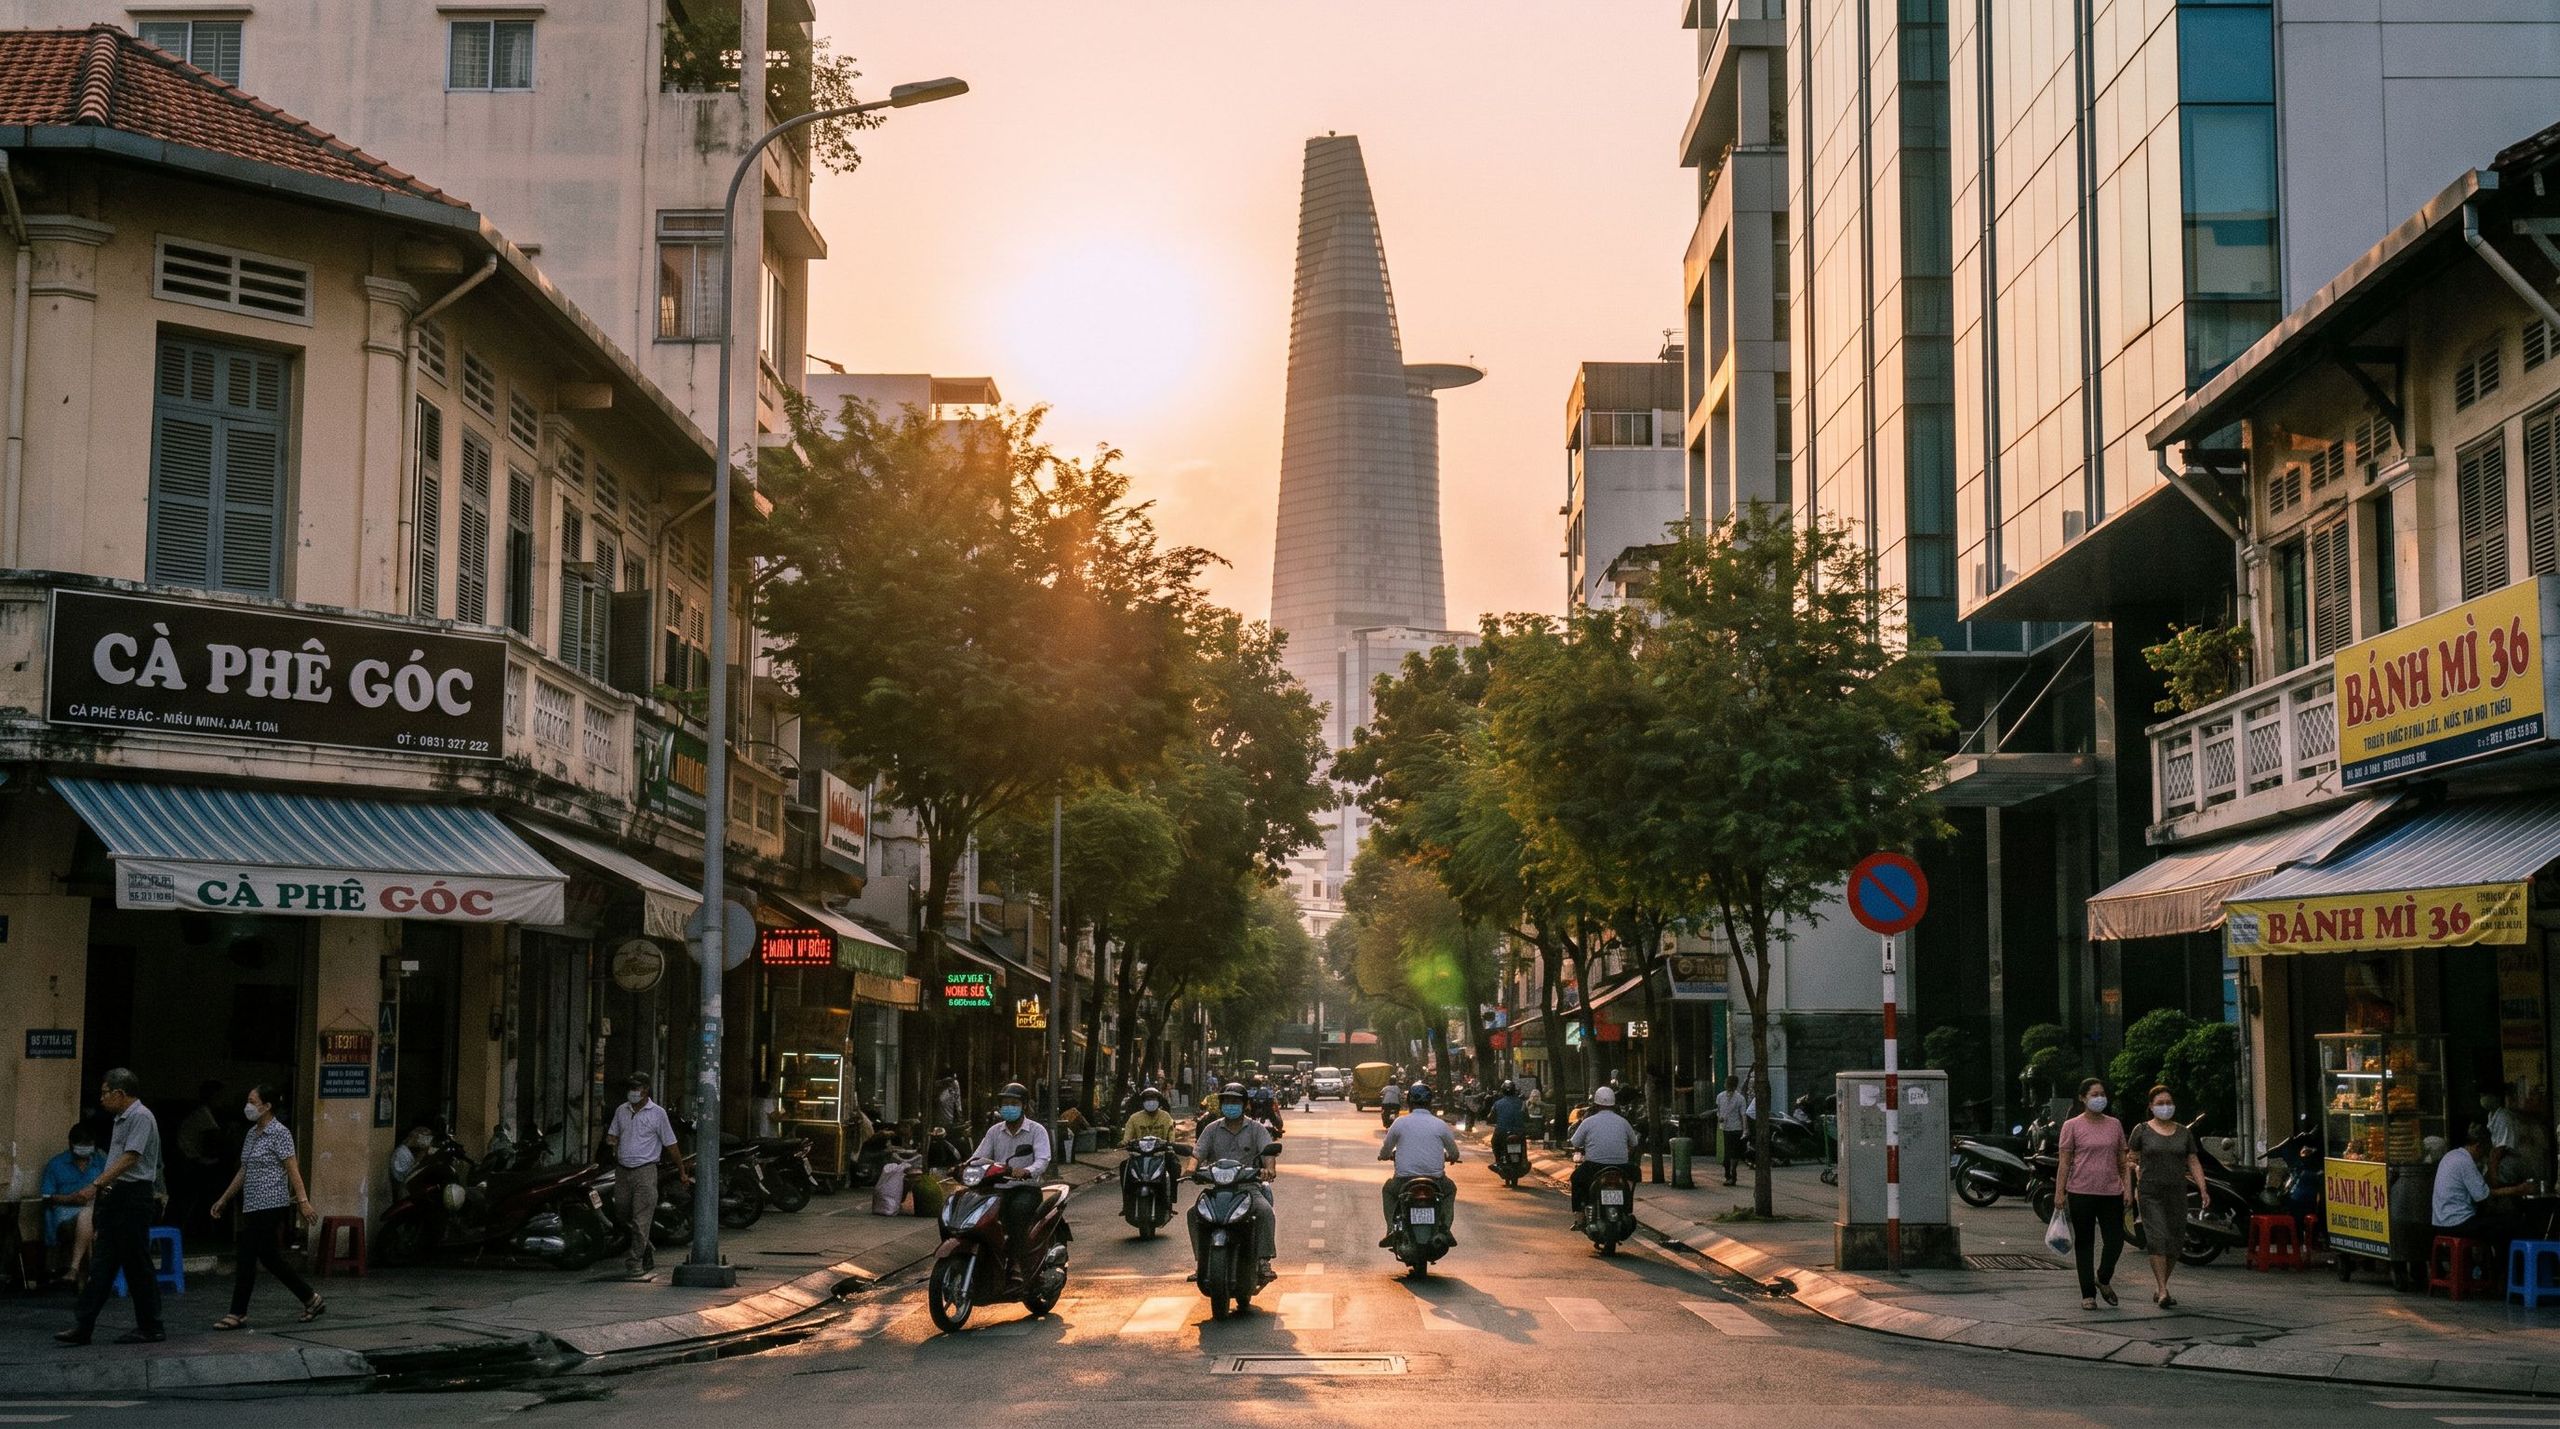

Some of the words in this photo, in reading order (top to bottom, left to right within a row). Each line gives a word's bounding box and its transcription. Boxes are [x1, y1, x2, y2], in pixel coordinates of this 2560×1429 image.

[93, 622, 187, 691] CÀ
[205, 637, 332, 704] PHÊ
[349, 649, 474, 716] GÓC
[2345, 650, 2432, 728] BÁNH
[2438, 612, 2480, 700] MÌ
[2489, 615, 2530, 689] 36
[447, 738, 466, 750] 327
[469, 740, 489, 752] 222
[198, 874, 263, 909] CÀ
[276, 878, 367, 911] PHÊ
[379, 880, 494, 916] GÓC
[2267, 902, 2365, 945] BÁNH
[2375, 895, 2420, 939] MÌ
[2428, 902, 2471, 940] 36
[2328, 1173, 2356, 1205] BÁNH
[2358, 1179, 2371, 1208] MÌ
[2373, 1184, 2386, 1212] 36
